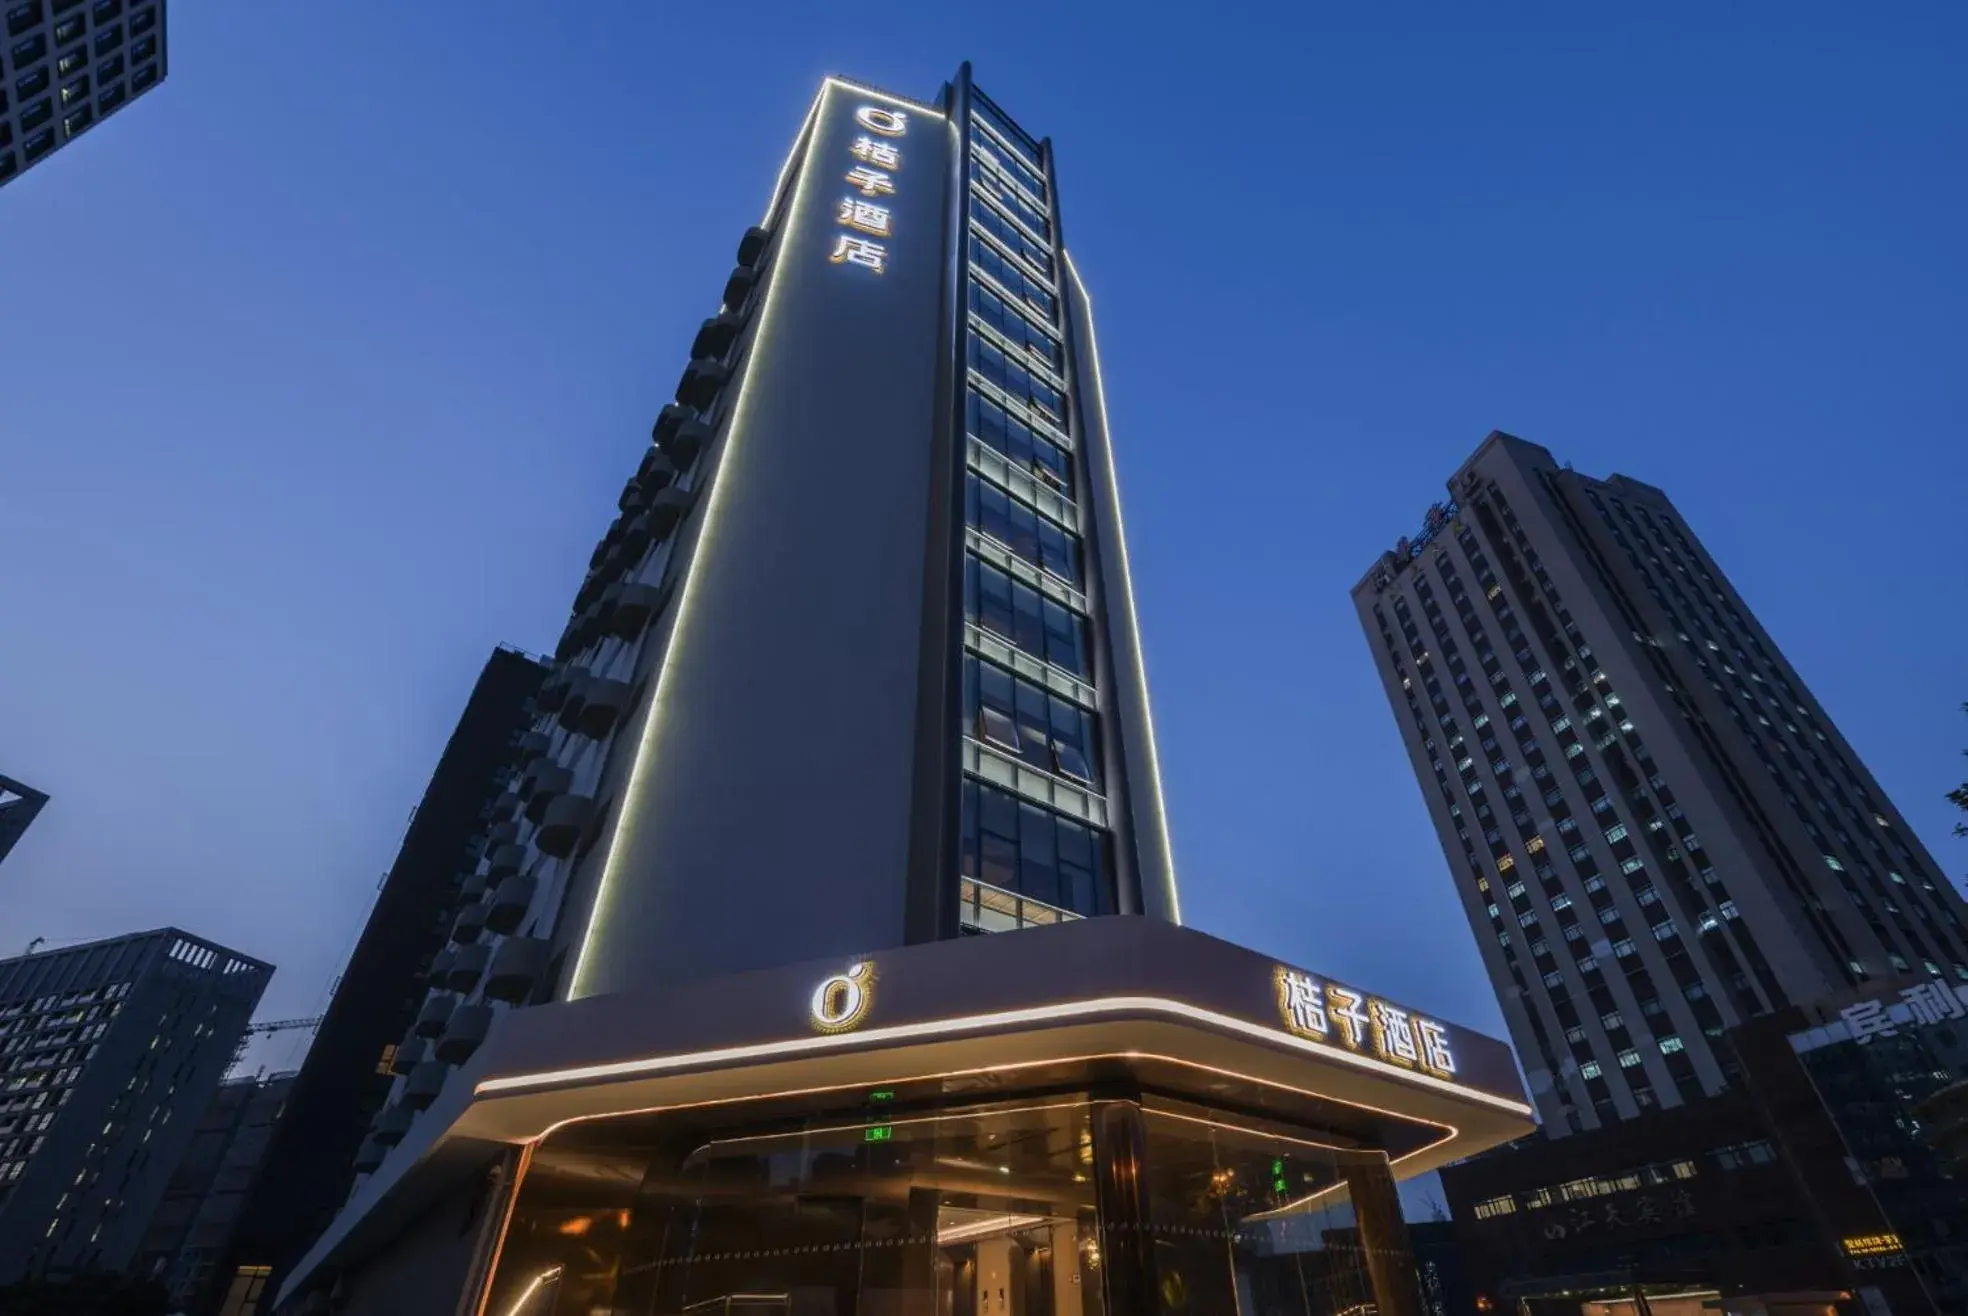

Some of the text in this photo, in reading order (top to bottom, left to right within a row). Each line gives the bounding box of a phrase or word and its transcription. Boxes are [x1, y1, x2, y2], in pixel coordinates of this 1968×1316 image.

[829, 136, 900, 274] 桔子酒店
[1275, 967, 1457, 1078] 桔子酒店
